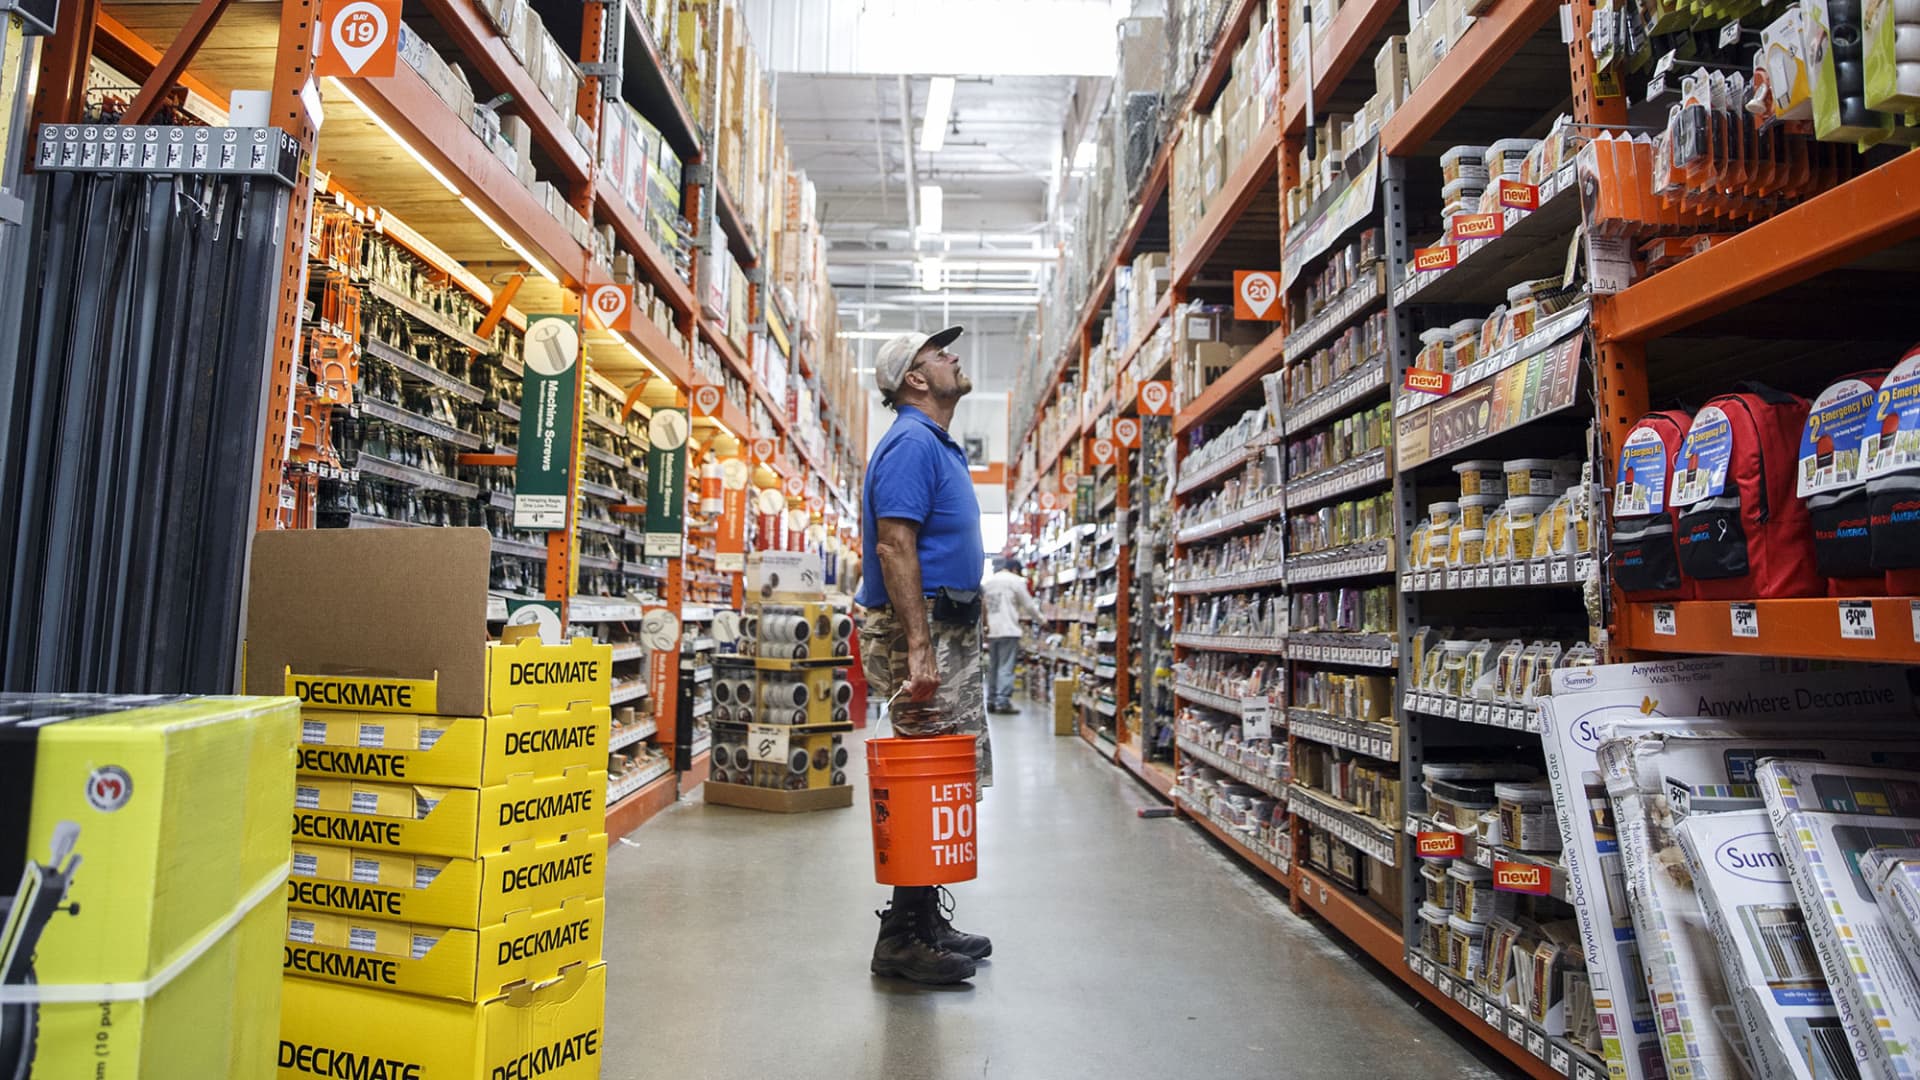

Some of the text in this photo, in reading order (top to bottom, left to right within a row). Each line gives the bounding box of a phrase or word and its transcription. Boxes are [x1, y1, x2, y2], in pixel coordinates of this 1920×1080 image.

[346, 22, 374, 42] 19
[46, 128, 57, 136] 29
[65, 128, 77, 137] 30
[85, 129, 96, 137] 31
[104, 130, 116, 138] 32
[123, 130, 135, 138] 33
[146, 130, 157, 138] 34
[170, 130, 183, 139] 35
[196, 131, 208, 139] 36
[224, 131, 236, 139] 37
[255, 131, 266, 139] 38
[281, 135, 298, 155] 6 Ft
[1503, 187, 1530, 202] new!
[1458, 216, 1494, 234] new!
[1419, 249, 1449, 266] new!
[600, 298, 618, 309] 17
[1250, 286, 1270, 299] 20
[1410, 374, 1443, 387] new!
[1809, 415, 1820, 443] 2
[1821, 402, 1860, 423] Emergency
[1862, 394, 1874, 408] Kit
[1877, 390, 1890, 422] 2
[542, 380, 559, 472] Machine Screws
[1685, 434, 1694, 459] 2
[1624, 449, 1630, 471] 2
[510, 660, 597, 686] DECKMATE
[1566, 677, 1594, 685] Summer
[1632, 661, 1723, 676] Anywhere Decorative
[1650, 674, 1691, 683] Walk-Thru
[295, 681, 411, 707] DECKMATE
[1697, 686, 1894, 716] Anywhere Decorative
[505, 725, 595, 756] DECKMATE
[1580, 721, 1601, 741] Su
[296, 749, 405, 777] DECKMATE
[1606, 745, 1622, 780] Summer
[931, 782, 972, 802] LET'S
[499, 789, 592, 826] DECKMATE
[1614, 795, 1625, 822] Extra
[292, 814, 400, 846] DECKMATE
[932, 804, 973, 841] DO
[1621, 823, 1630, 842] Tall
[931, 842, 976, 866] THIS.
[1421, 838, 1454, 851] new!
[1678, 832, 1698, 874] Summer
[1550, 753, 1598, 964] Anywhere Decorative Walk-Thru Gate
[502, 853, 592, 894] DECKMATE
[1500, 869, 1539, 883] new!
[1625, 843, 1639, 900] Walk-Th
[1802, 866, 1815, 896] Gate
[288, 880, 400, 914] DECKMATE
[1894, 881, 1918, 921] Summer
[1814, 898, 1831, 936] Metal
[498, 919, 590, 966] DECKMATE
[284, 946, 396, 985] DECKMATE
[1819, 939, 1840, 986] Simple
[1831, 938, 1851, 987] Secure
[1836, 986, 1854, 1026] Stairs
[1850, 987, 1860, 1005] to
[1847, 1021, 1859, 1039] of
[1859, 1009, 1881, 1059] Simple
[278, 1040, 421, 1080] DECKMATE
[491, 1028, 598, 1080] DECKMATE
[1755, 1035, 1772, 1078] Secure
[1855, 1040, 1869, 1066] Top
